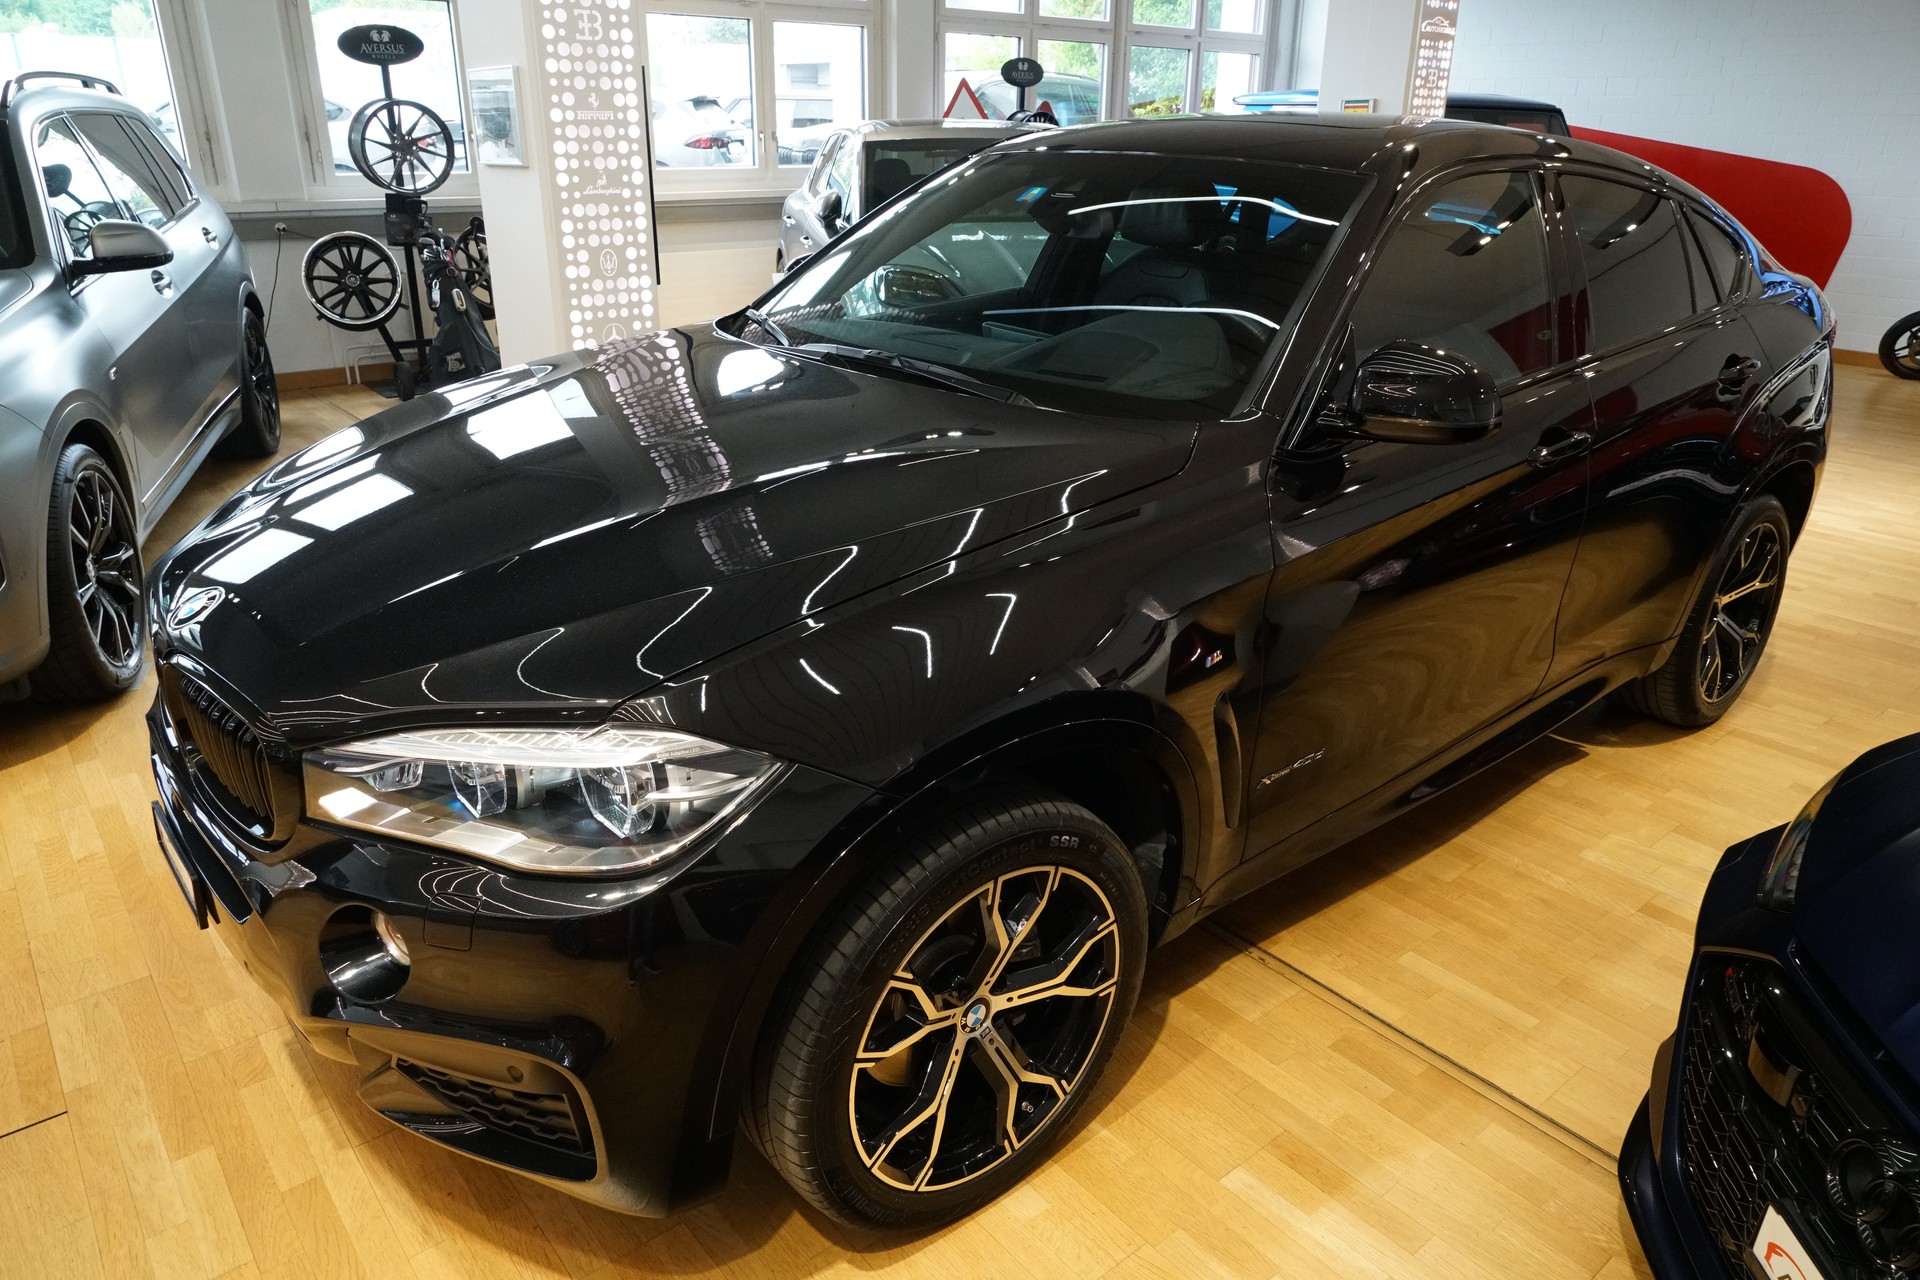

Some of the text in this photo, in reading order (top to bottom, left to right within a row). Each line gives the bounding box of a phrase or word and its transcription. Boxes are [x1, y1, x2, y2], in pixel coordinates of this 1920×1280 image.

[360, 43, 405, 54] AVERSUS
[576, 110, 614, 120] Ferrari
[1050, 835, 1080, 848] SSR
